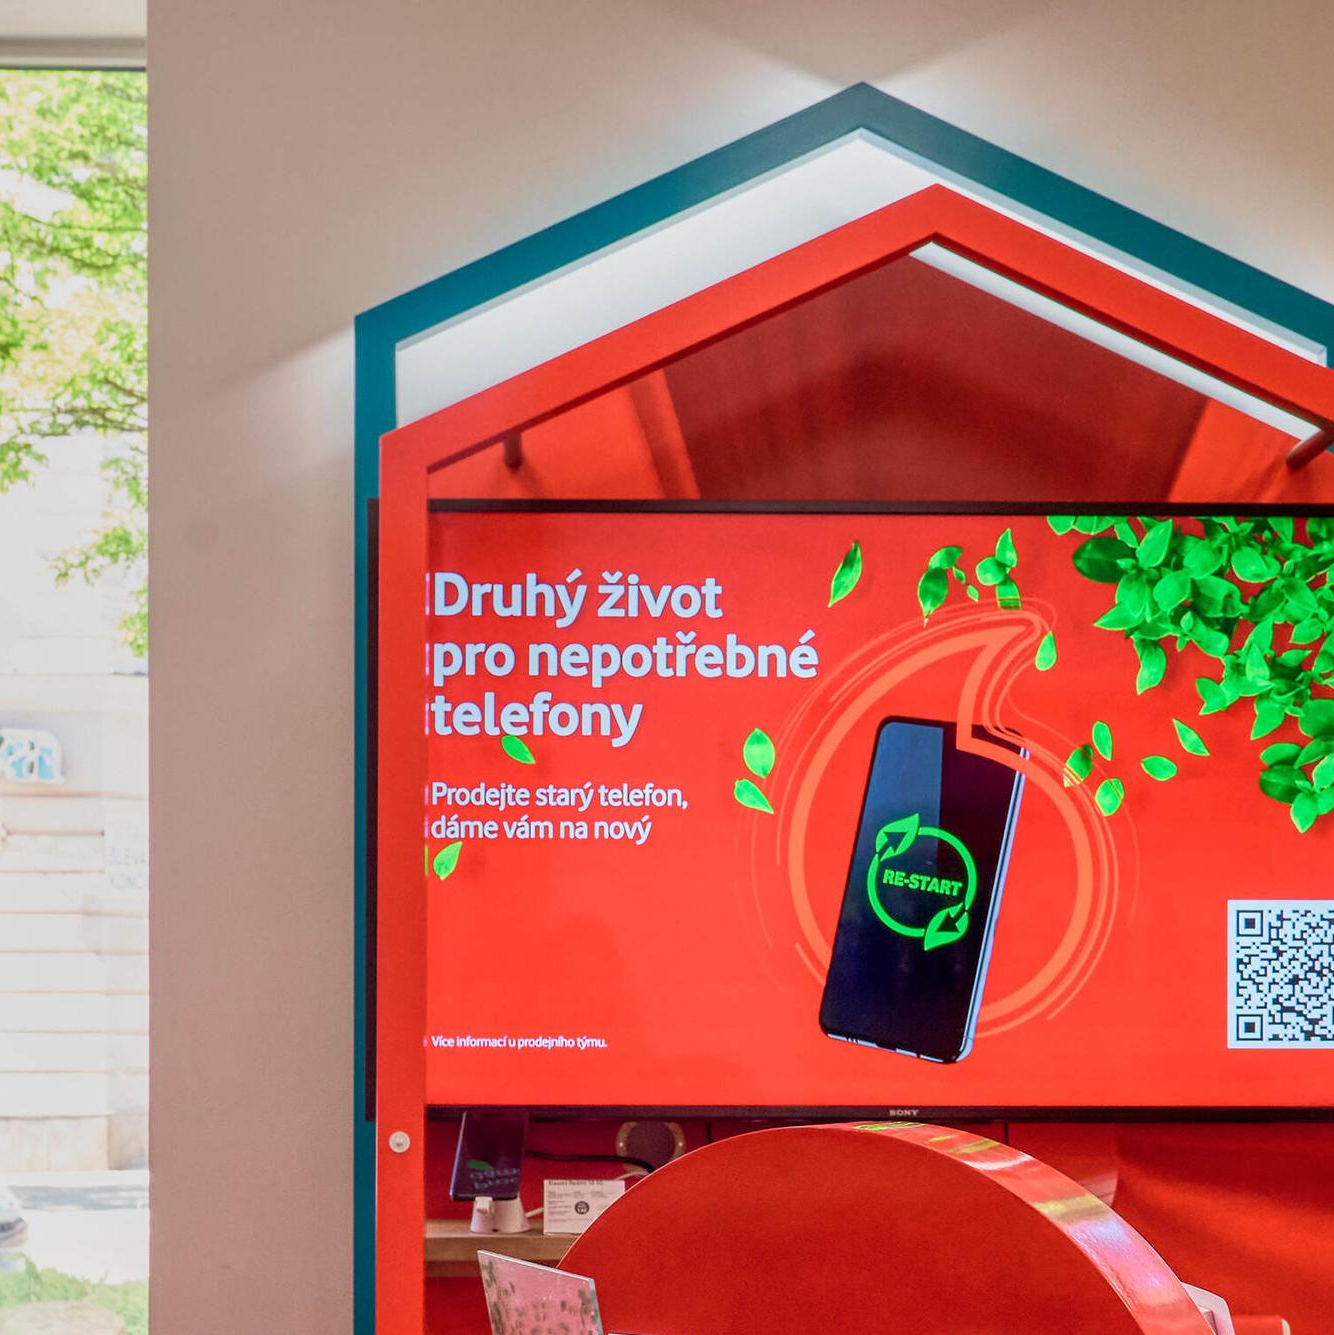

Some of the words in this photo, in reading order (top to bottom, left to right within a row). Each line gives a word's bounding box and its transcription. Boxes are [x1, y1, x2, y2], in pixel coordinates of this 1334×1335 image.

[434, 568, 586, 628] Druhý
[597, 570, 722, 618] život
[433, 643, 515, 686] pro
[529, 630, 818, 687] nepotřebné
[431, 691, 643, 748] telefony
[431, 782, 530, 812] Prodejte
[535, 781, 594, 812] starý
[598, 782, 688, 810] telefon,
[431, 813, 498, 840] dáme
[502, 814, 554, 840] vám
[560, 821, 588, 840] na
[593, 814, 652, 846] nový
[883, 869, 963, 896] RE-START
[431, 1036, 455, 1047] Více
[456, 1035, 507, 1048] informací
[508, 1038, 516, 1047] u
[517, 1036, 575, 1050] prodejního
[576, 1036, 608, 1050] týmu.
